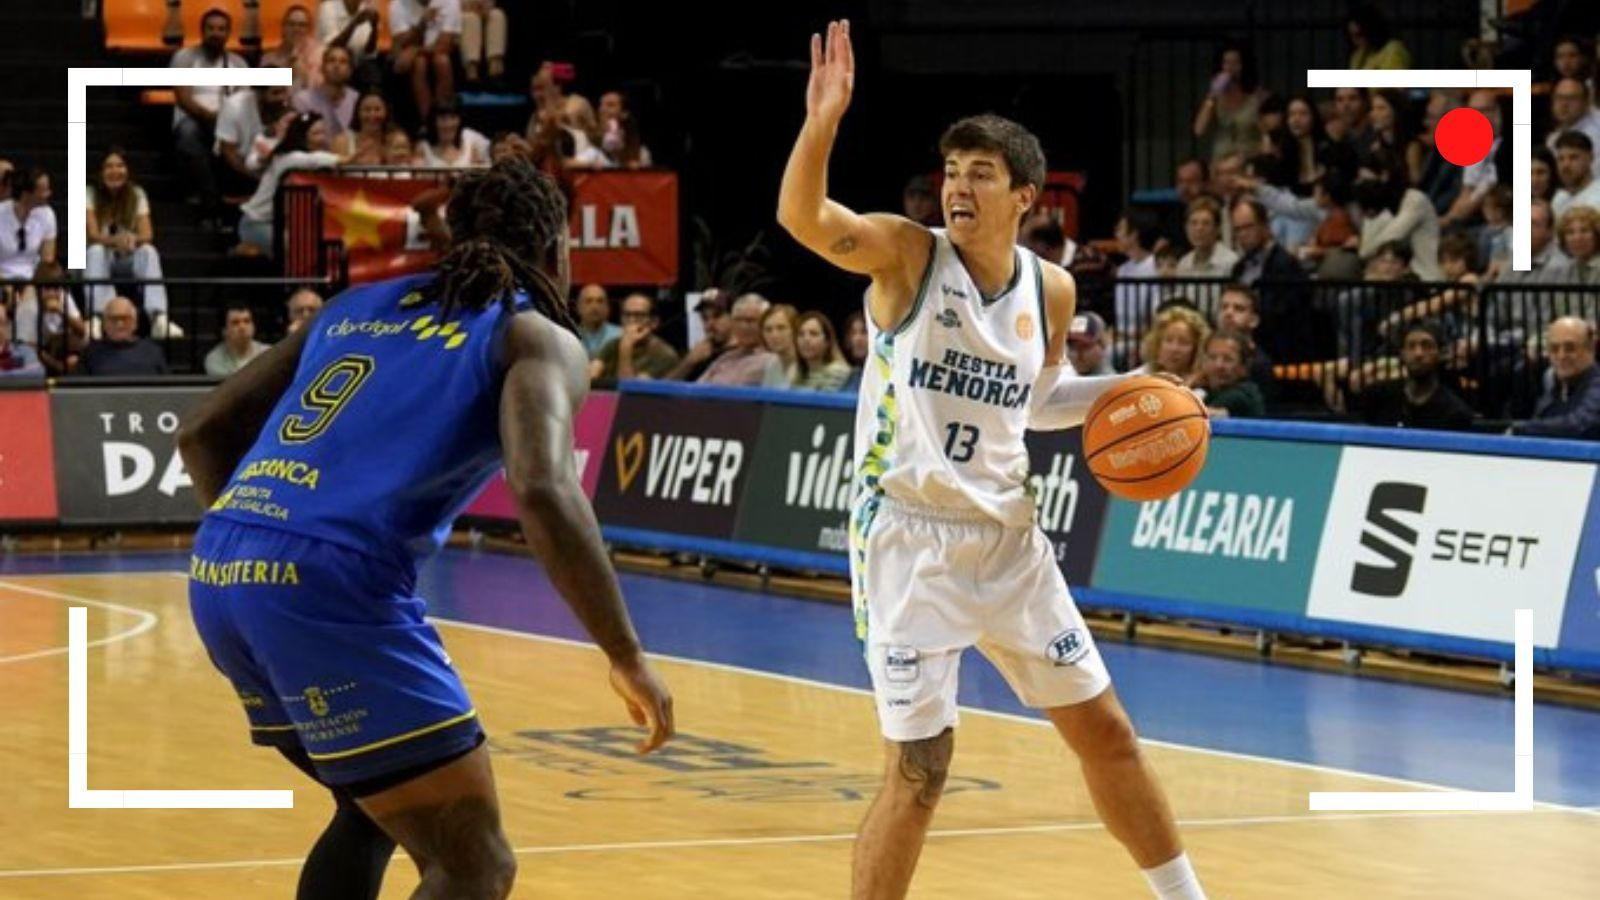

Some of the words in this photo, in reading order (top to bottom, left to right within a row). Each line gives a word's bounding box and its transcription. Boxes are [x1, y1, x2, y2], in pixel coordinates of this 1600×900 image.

[908, 357, 1031, 409] MENORCA
[942, 347, 1018, 381] HESTIA
[279, 354, 375, 445] 9
[944, 421, 980, 463] 13
[645, 433, 744, 507] VIPER
[1431, 529, 1540, 569] SEAT
